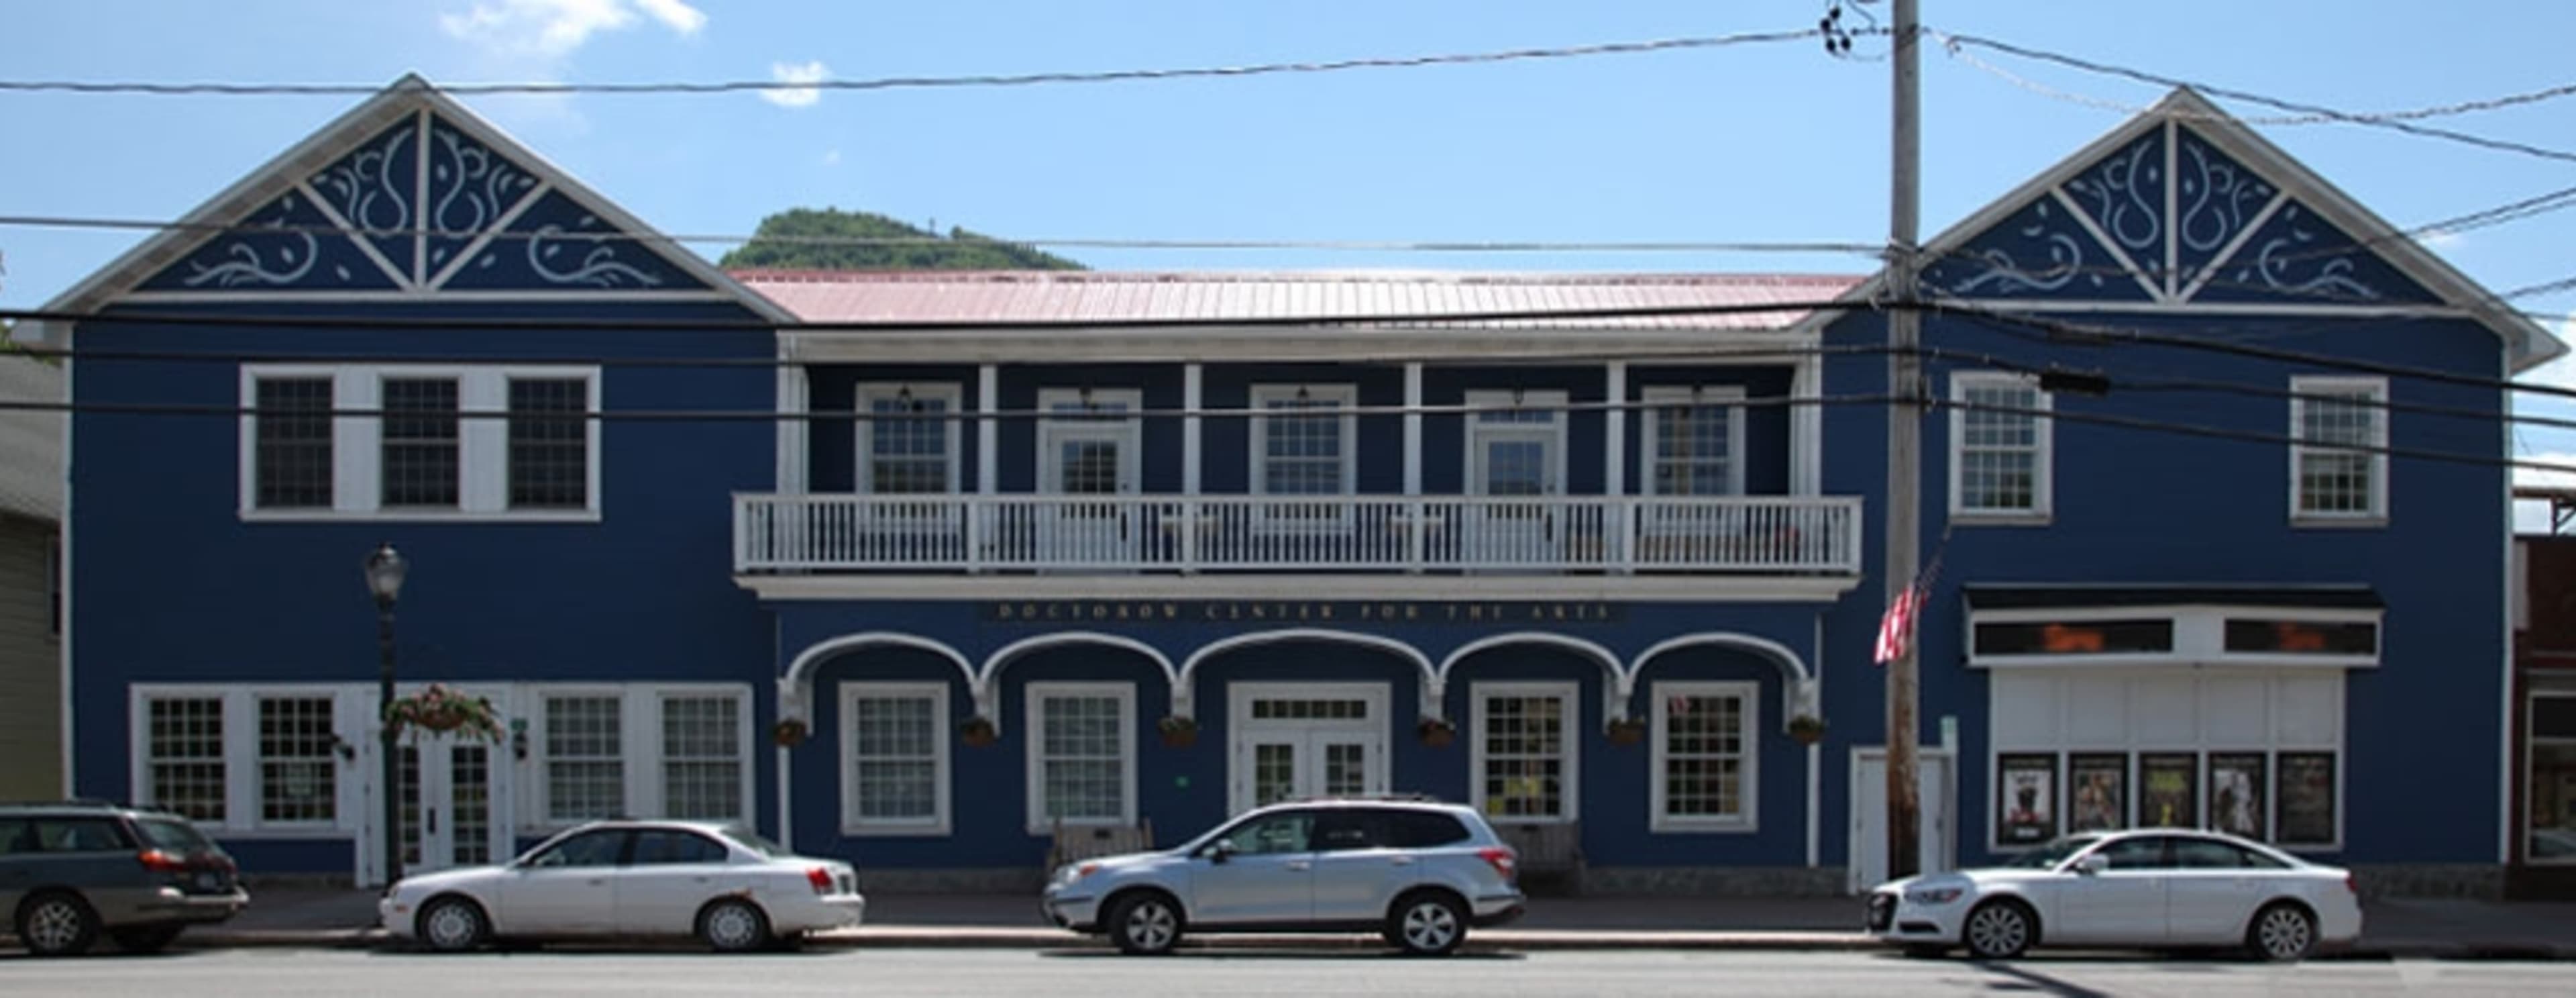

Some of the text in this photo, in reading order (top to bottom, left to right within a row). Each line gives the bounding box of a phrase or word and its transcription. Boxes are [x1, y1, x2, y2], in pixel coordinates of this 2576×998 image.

[1207, 604, 1333, 619] CENTER
[1360, 604, 1417, 619] FOR
[1446, 604, 1503, 619] THE
[1532, 604, 1608, 619] ARTS
